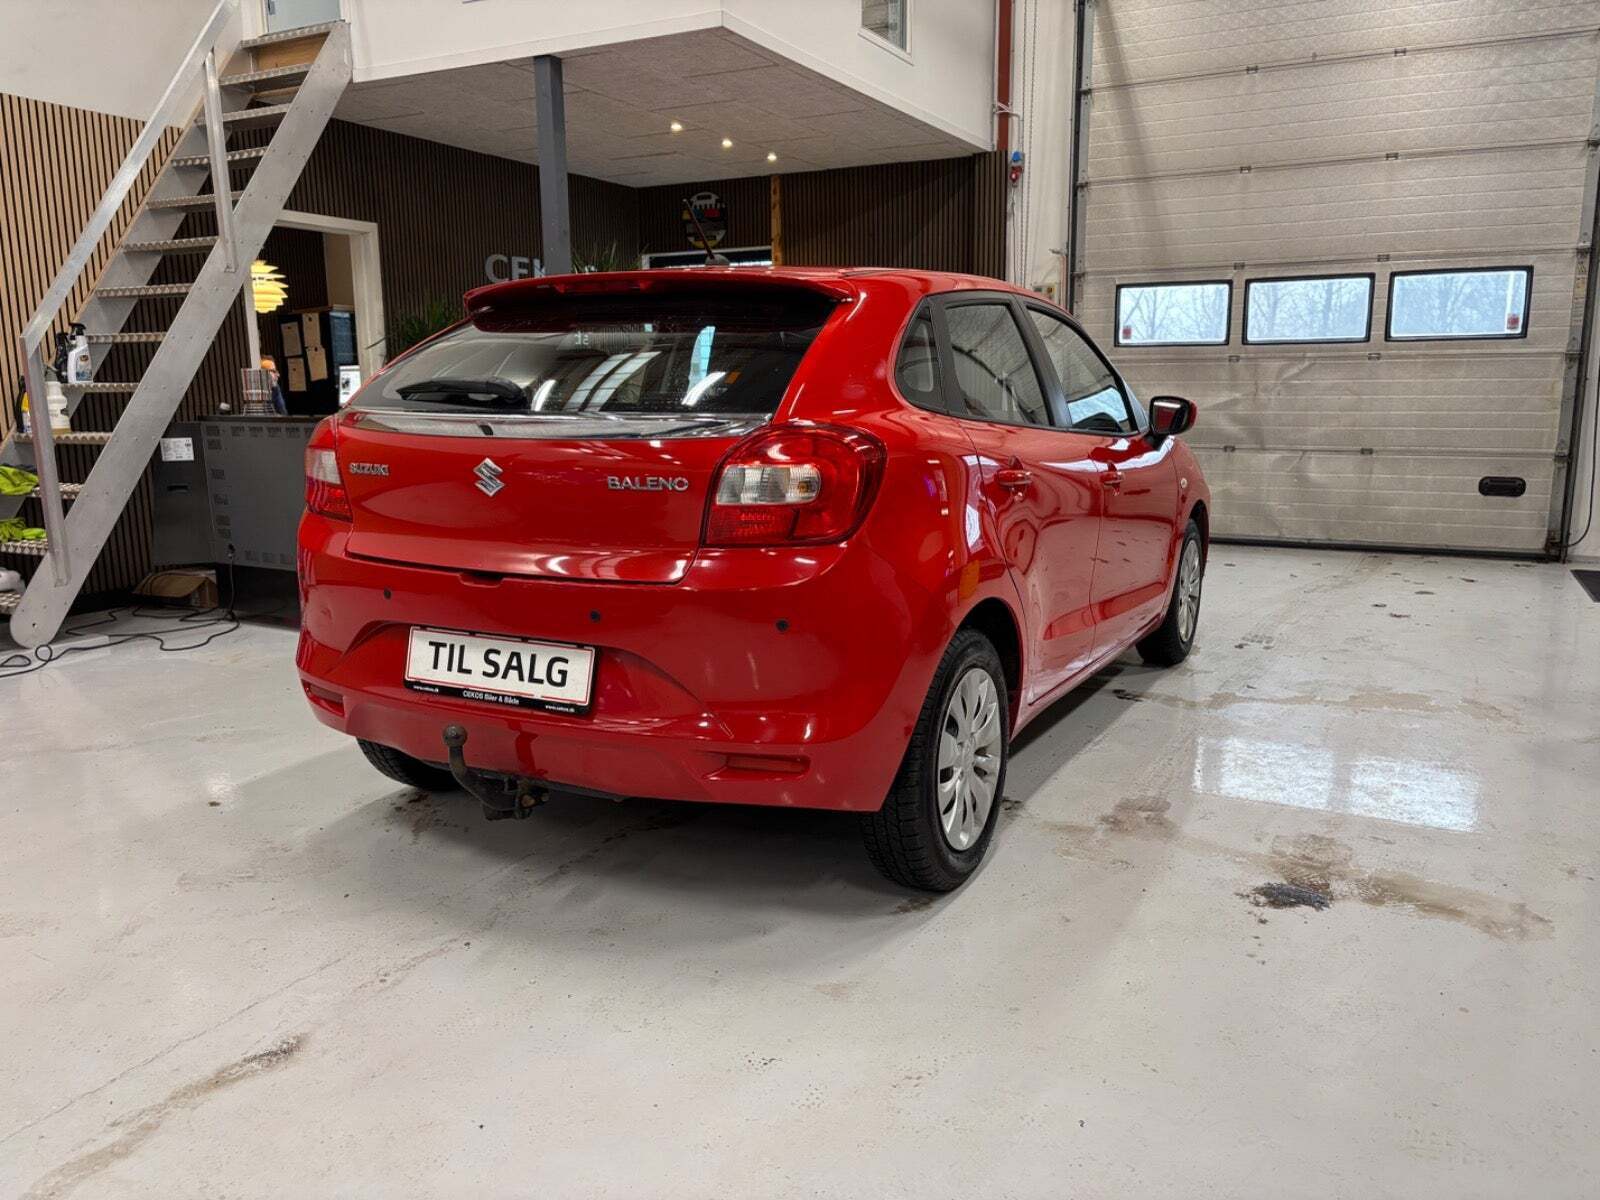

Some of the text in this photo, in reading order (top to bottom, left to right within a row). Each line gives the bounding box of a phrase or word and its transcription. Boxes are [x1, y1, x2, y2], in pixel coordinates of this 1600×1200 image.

[350, 462, 390, 476] SUZUKI
[607, 475, 689, 491] BALENO
[429, 641, 569, 688] TIL SALG
